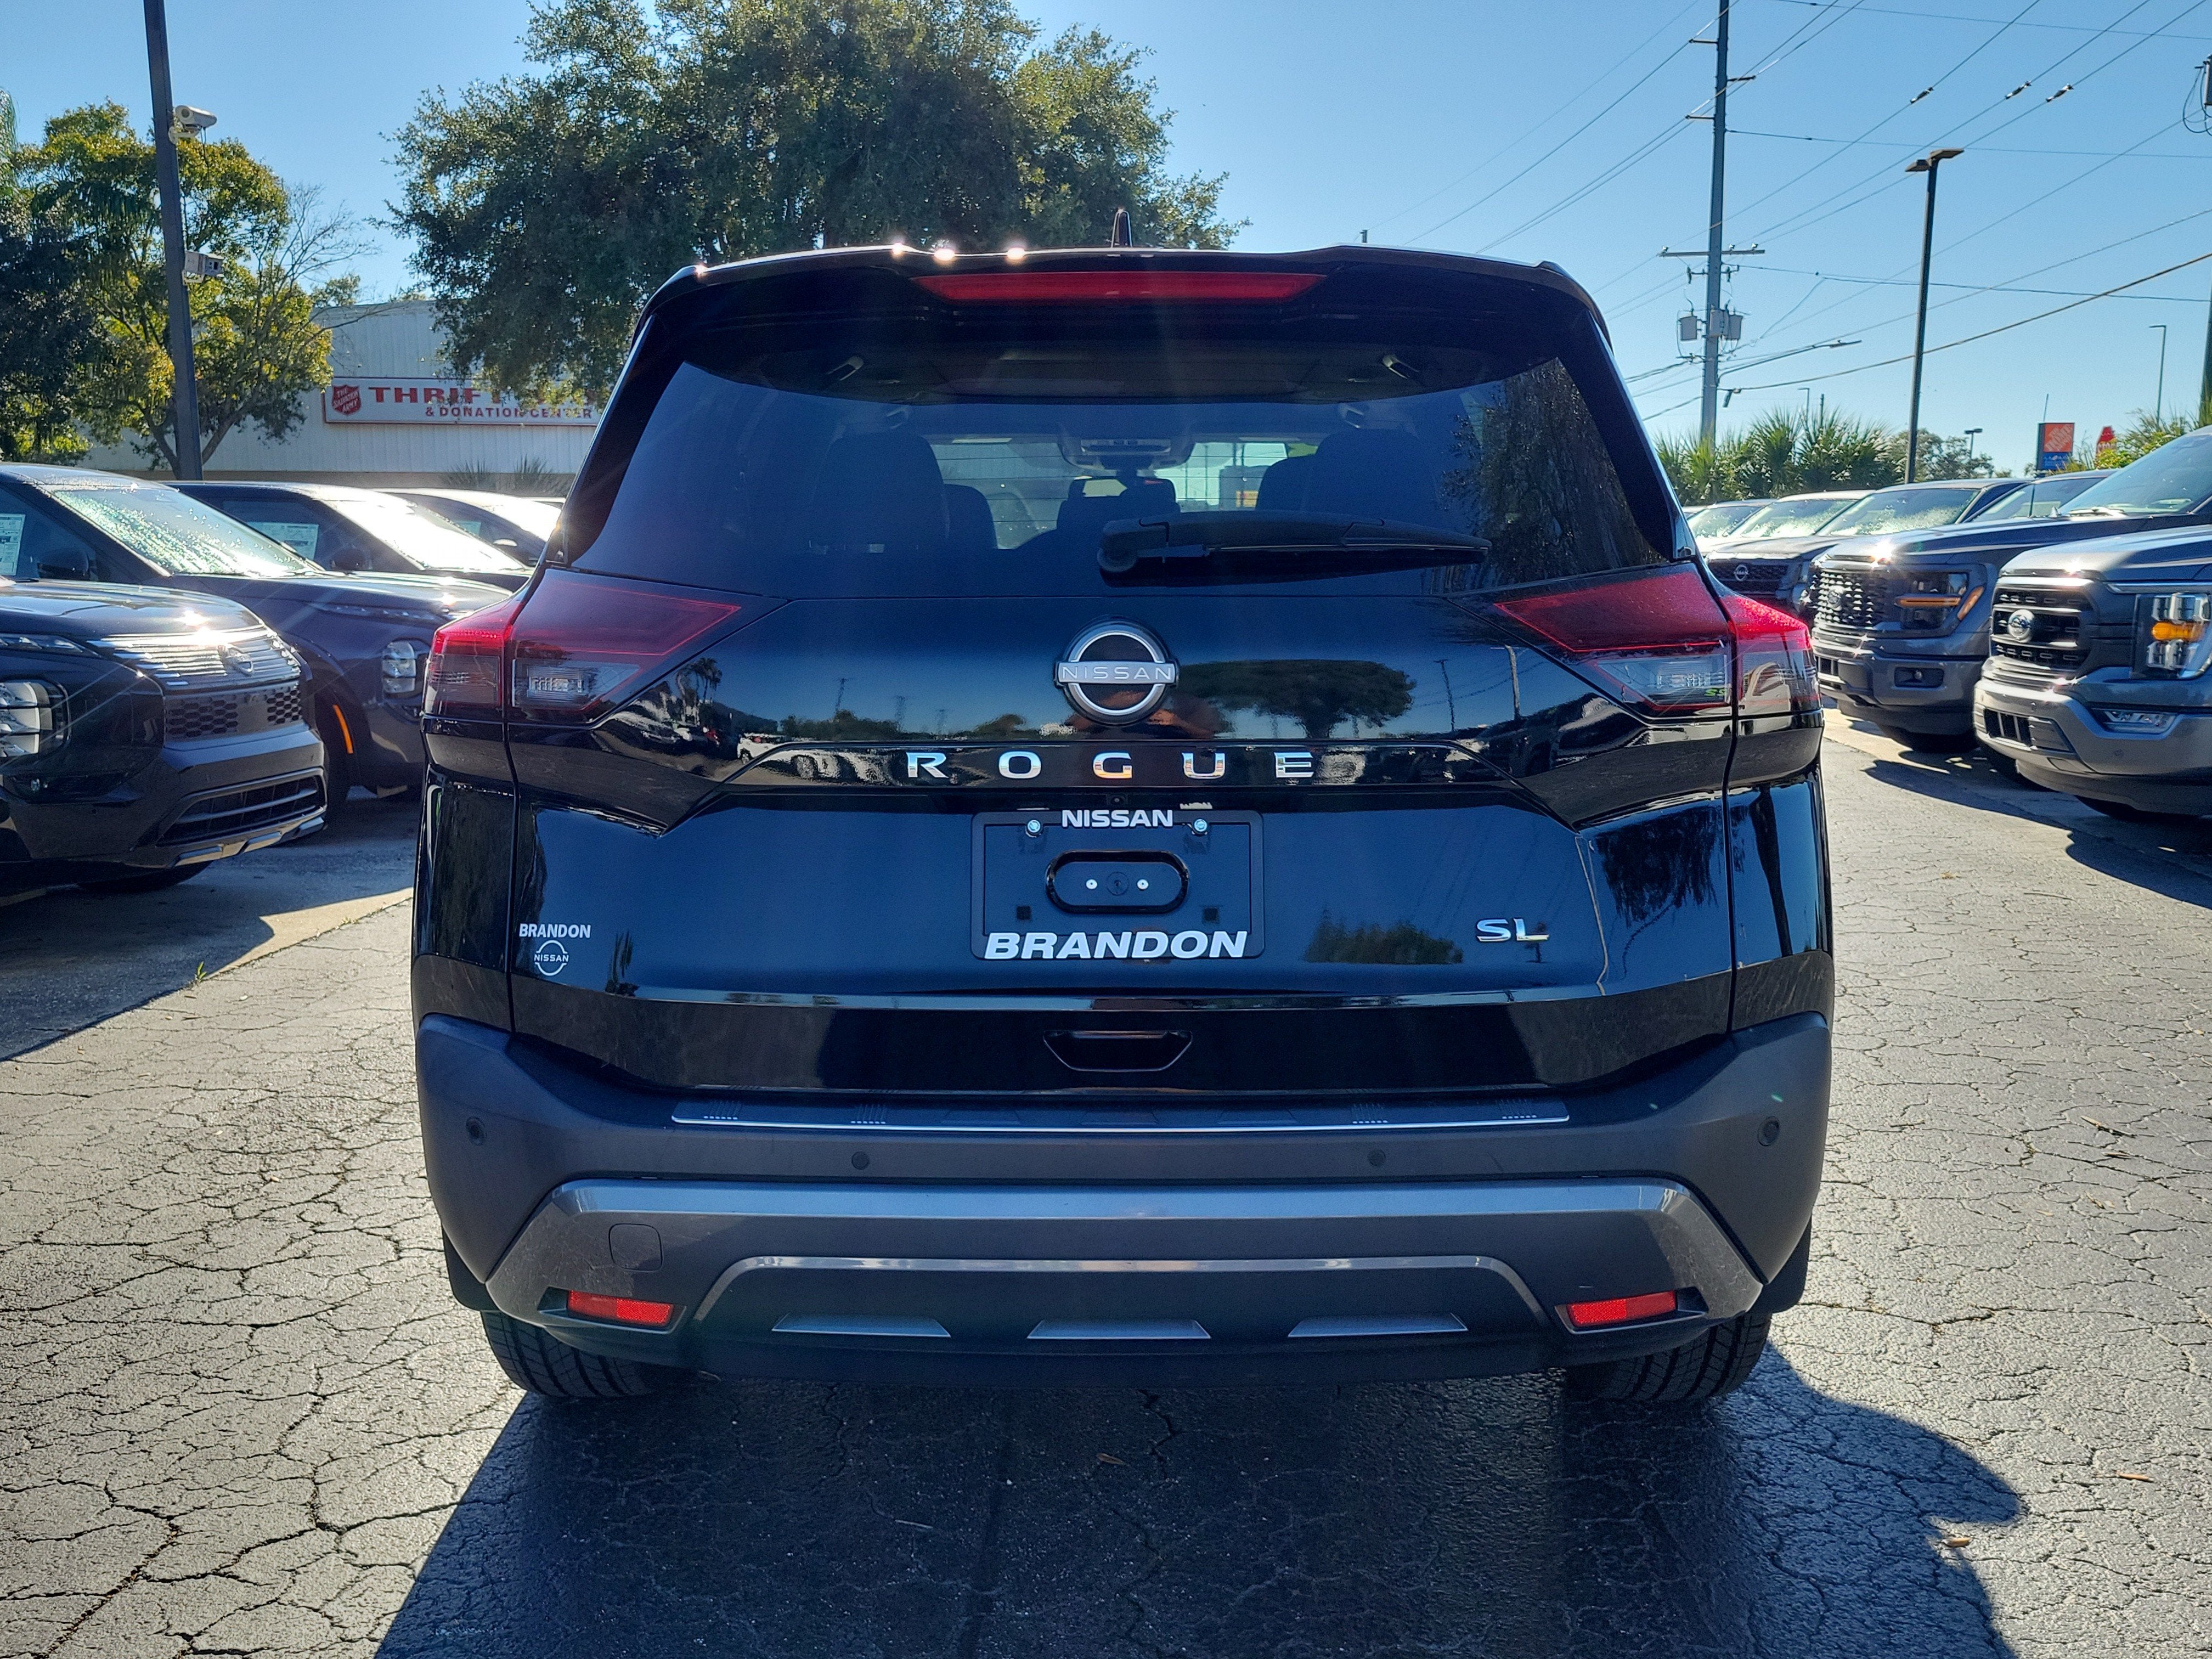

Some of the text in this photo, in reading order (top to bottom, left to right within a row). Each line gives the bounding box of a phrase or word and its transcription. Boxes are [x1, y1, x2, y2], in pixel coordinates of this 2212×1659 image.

[426, 407, 435, 417] &
[531, 408, 592, 419] CENR
[1062, 665, 1172, 680] NISSAN
[907, 751, 1314, 780] ROGUE
[1062, 809, 1173, 828] NISSAN
[518, 923, 591, 939] BRANDON
[1477, 918, 1550, 942] SL
[984, 930, 1248, 960] BRANDON
[534, 953, 569, 962] NISSAN
